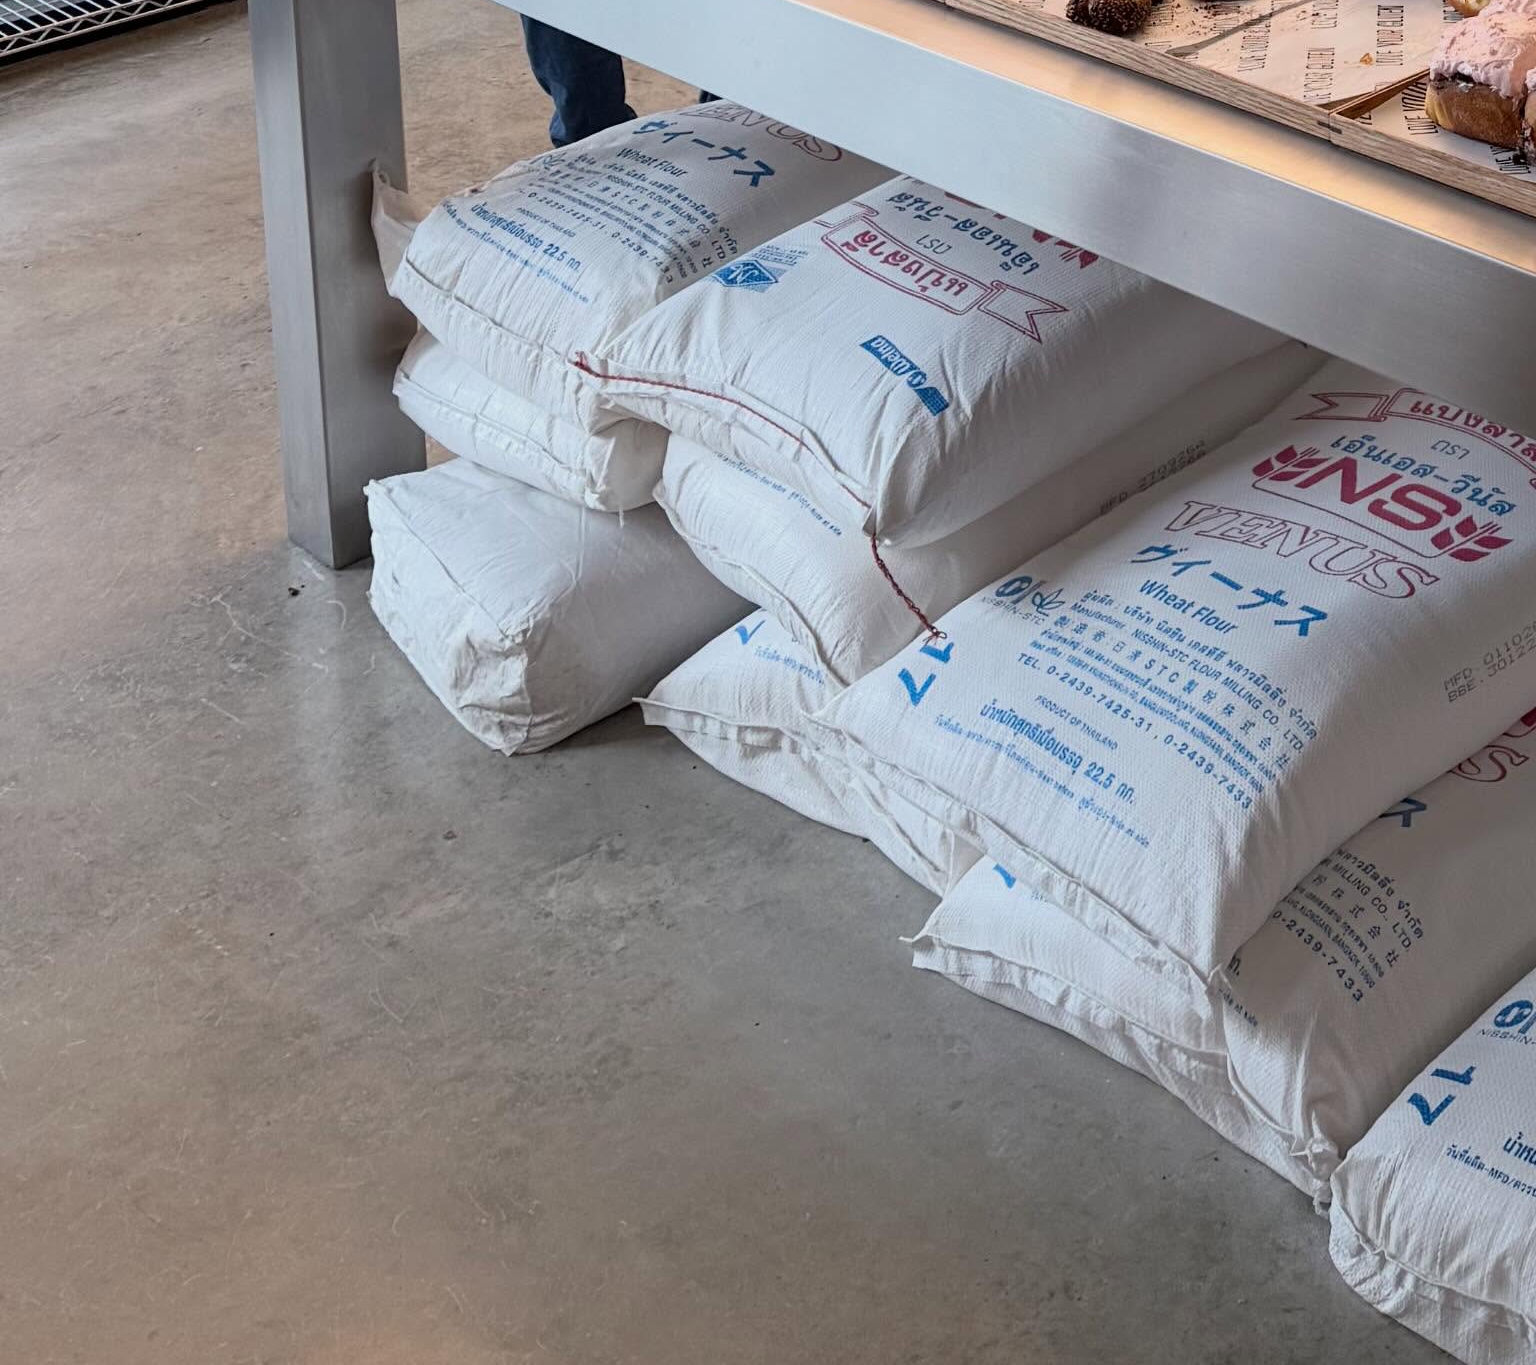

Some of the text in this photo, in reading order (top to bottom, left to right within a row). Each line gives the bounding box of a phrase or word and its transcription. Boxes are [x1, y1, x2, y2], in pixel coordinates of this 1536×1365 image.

[617, 148, 688, 179] Wheat Flour
[633, 120, 776, 187] ヴィーナス
[543, 243, 567, 262] 22.5
[842, 230, 969, 297] แป้งสาลี
[916, 234, 952, 255] ตรา
[1330, 434, 1517, 518] เอ็นเอส-วีนัส
[1431, 438, 1470, 460] ตรา
[1299, 456, 1463, 531] NS
[1164, 500, 1441, 600] VENUS
[1131, 542, 1328, 638] ヴィーナス
[1139, 578, 1239, 635] Wheat Flour
[1131, 628, 1190, 663] NISSHIN-STC
[1187, 659, 1222, 682] FLOUR
[1221, 676, 1263, 710] MILLING
[1017, 652, 1042, 671] TEL.
[1046, 664, 1154, 733] 0-2439-7425-31
[1163, 733, 1254, 810] 0-2439-7433
[1034, 694, 1071, 720] PRODUCT
[1082, 721, 1119, 752] THAILAND
[1083, 760, 1117, 790] 22.5
[1331, 863, 1371, 897] MILLING
[1397, 899, 1424, 940] จำกัด
[1272, 911, 1364, 1003] 0-2439-7433
